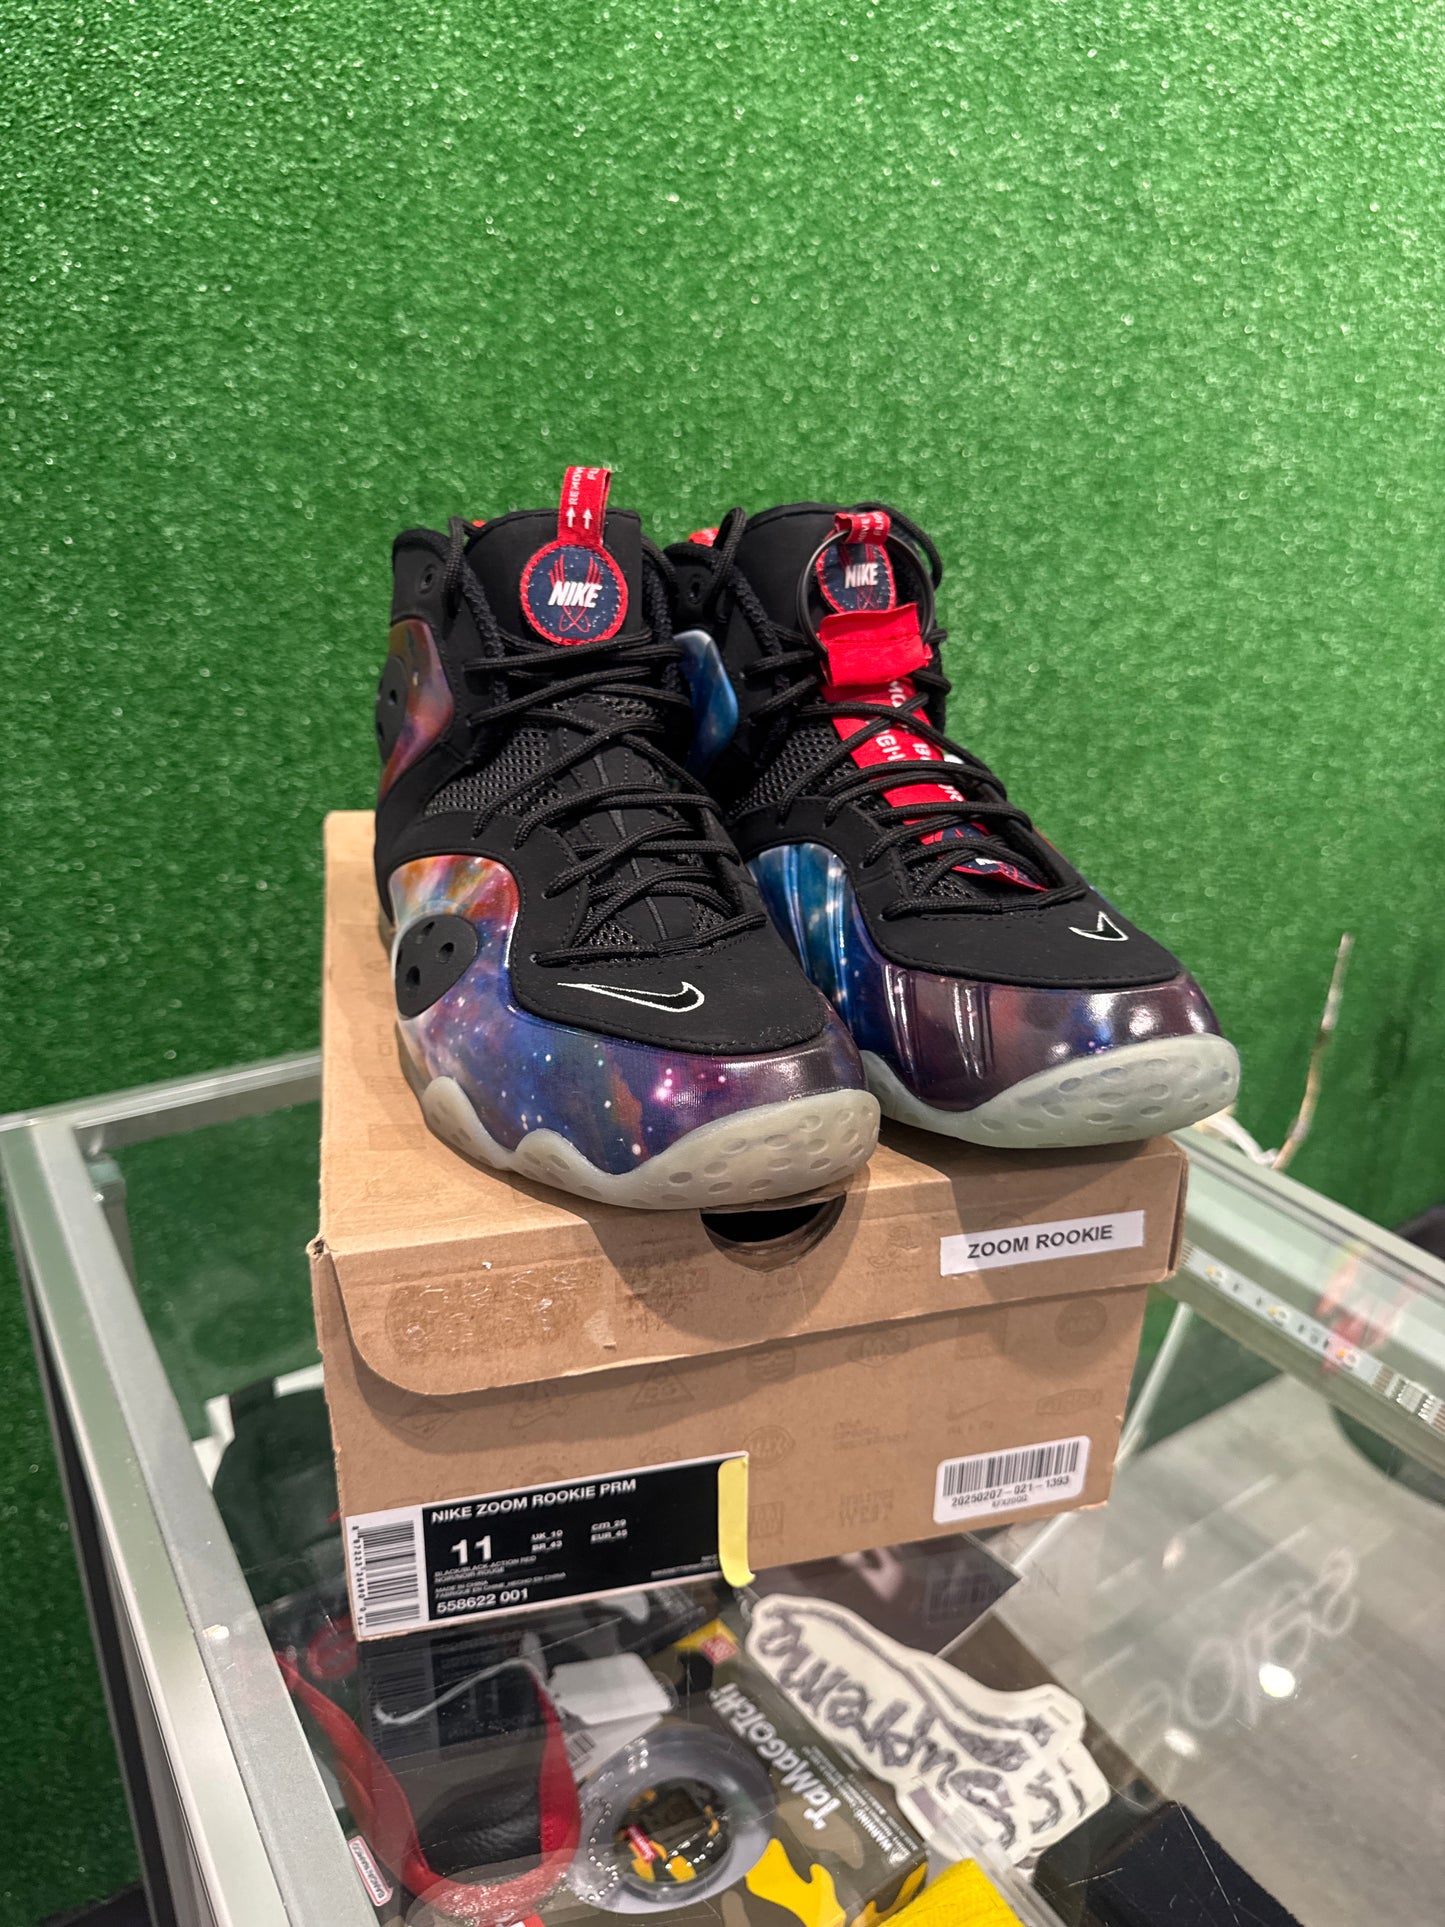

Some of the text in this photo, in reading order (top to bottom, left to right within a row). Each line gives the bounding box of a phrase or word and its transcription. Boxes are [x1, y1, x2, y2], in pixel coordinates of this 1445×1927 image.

[844, 563, 879, 589] NIKE
[547, 581, 603, 608] NIKE
[967, 1224, 1114, 1259] ZOOM ROOKIE
[430, 1478, 637, 1525] NIKE ZOOM ROOKIE PRM
[450, 1535, 493, 1565] 11
[436, 1587, 530, 1614] 558622 001
